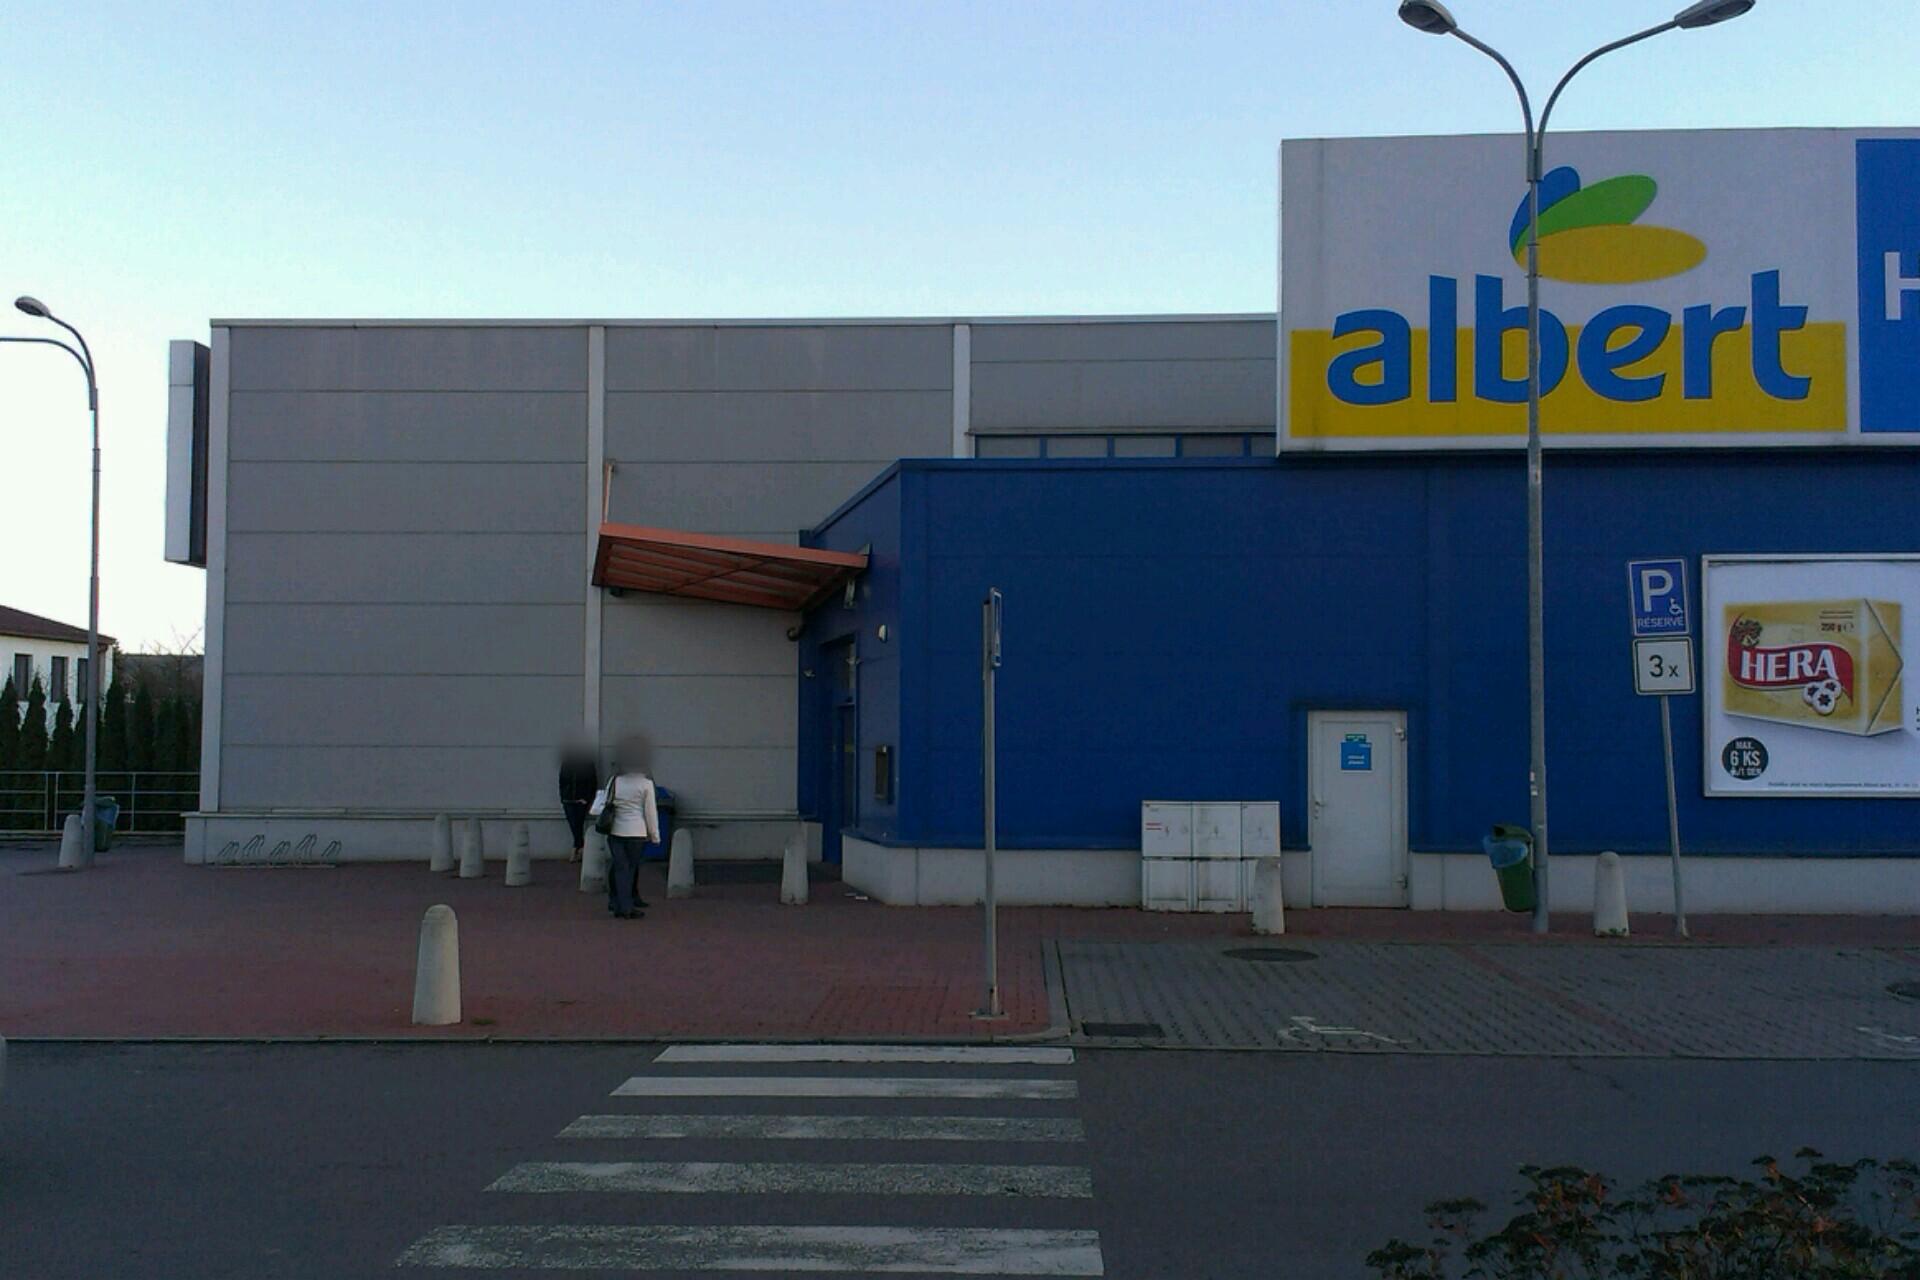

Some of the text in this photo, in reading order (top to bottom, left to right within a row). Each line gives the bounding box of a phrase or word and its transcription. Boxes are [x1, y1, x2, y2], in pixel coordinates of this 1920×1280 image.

[1327, 269, 1813, 406] albert
[1641, 569, 1674, 612] P
[1741, 649, 1839, 681] HERA
[1730, 750, 1761, 767] 6 KS
